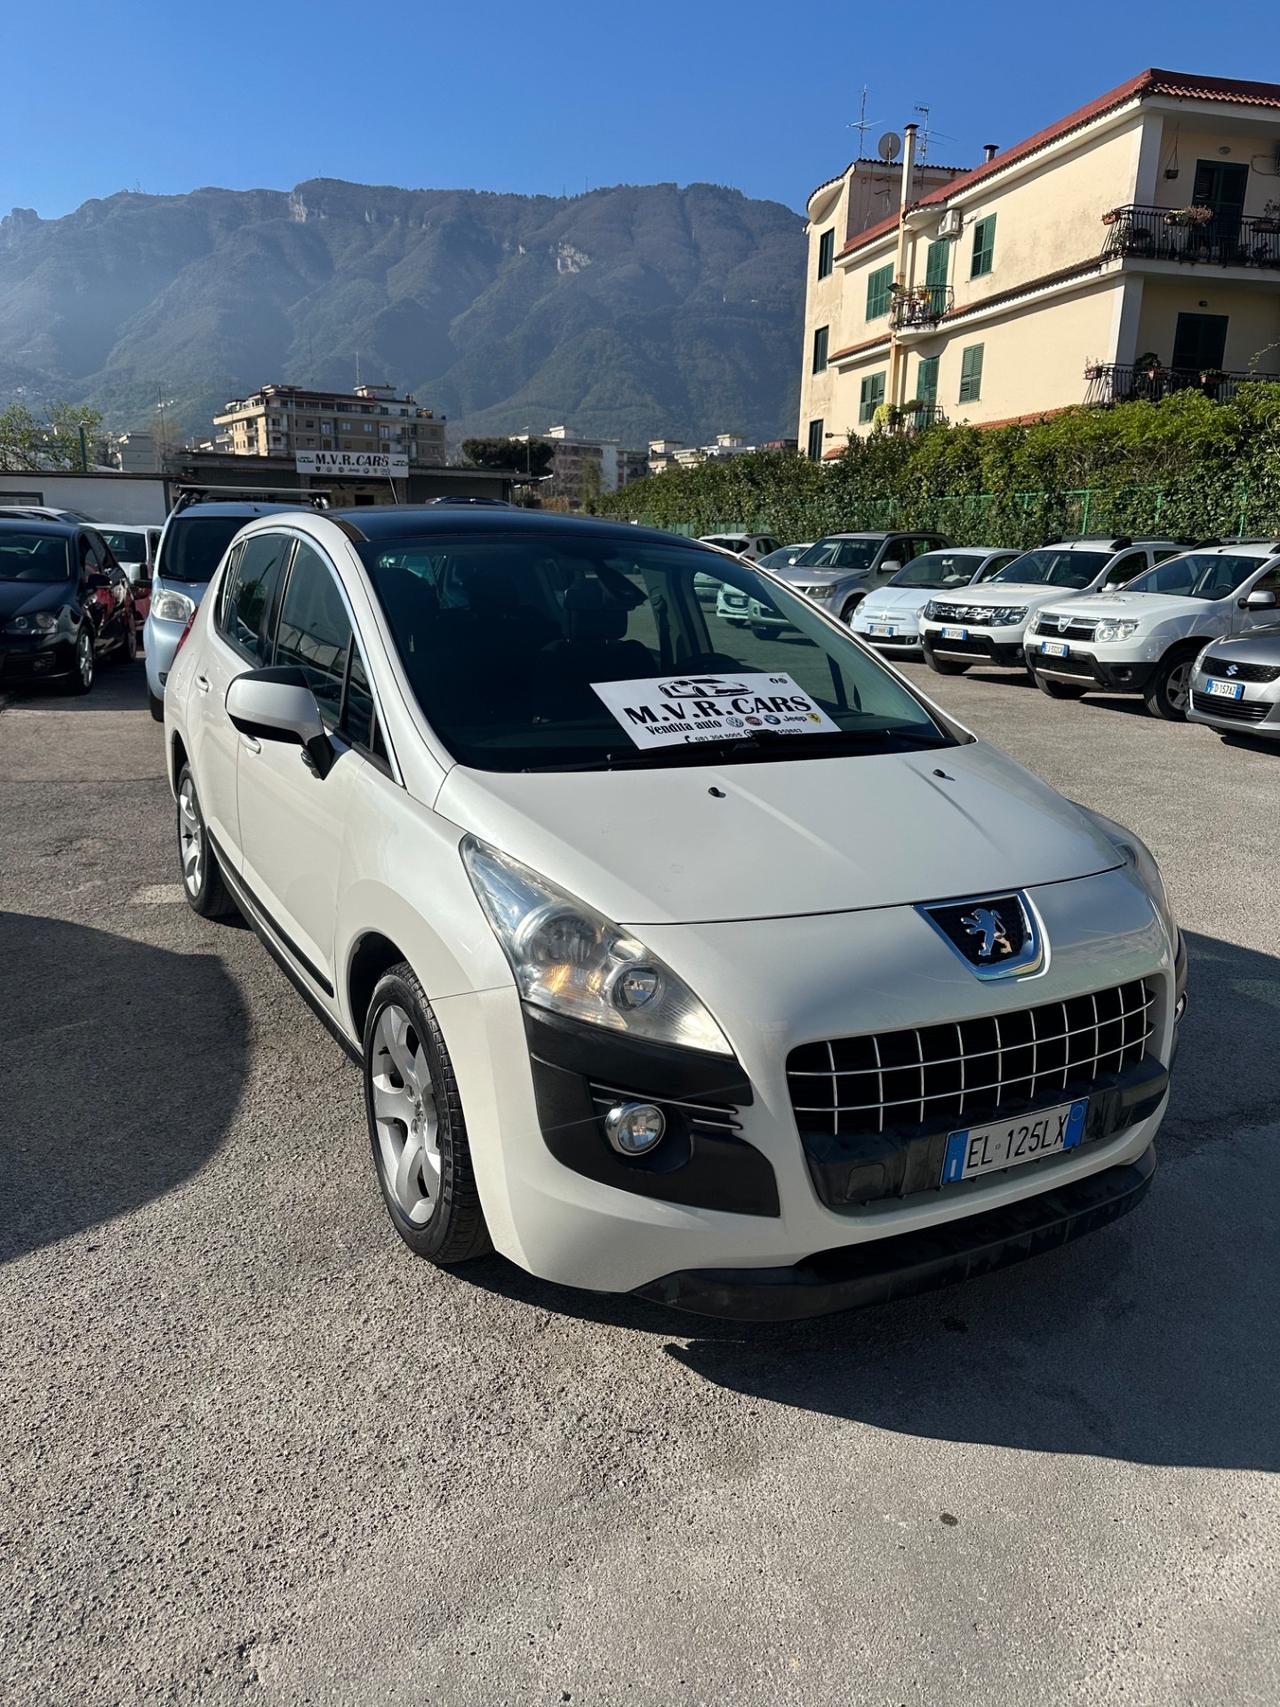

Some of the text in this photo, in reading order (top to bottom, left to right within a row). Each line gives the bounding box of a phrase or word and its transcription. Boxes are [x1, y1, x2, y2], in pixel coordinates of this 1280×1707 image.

[645, 719, 722, 735] Vendita auto
[783, 715, 807, 723] Jeep
[966, 1135, 993, 1169] EL
[1005, 1113, 1069, 1160] 125LX
